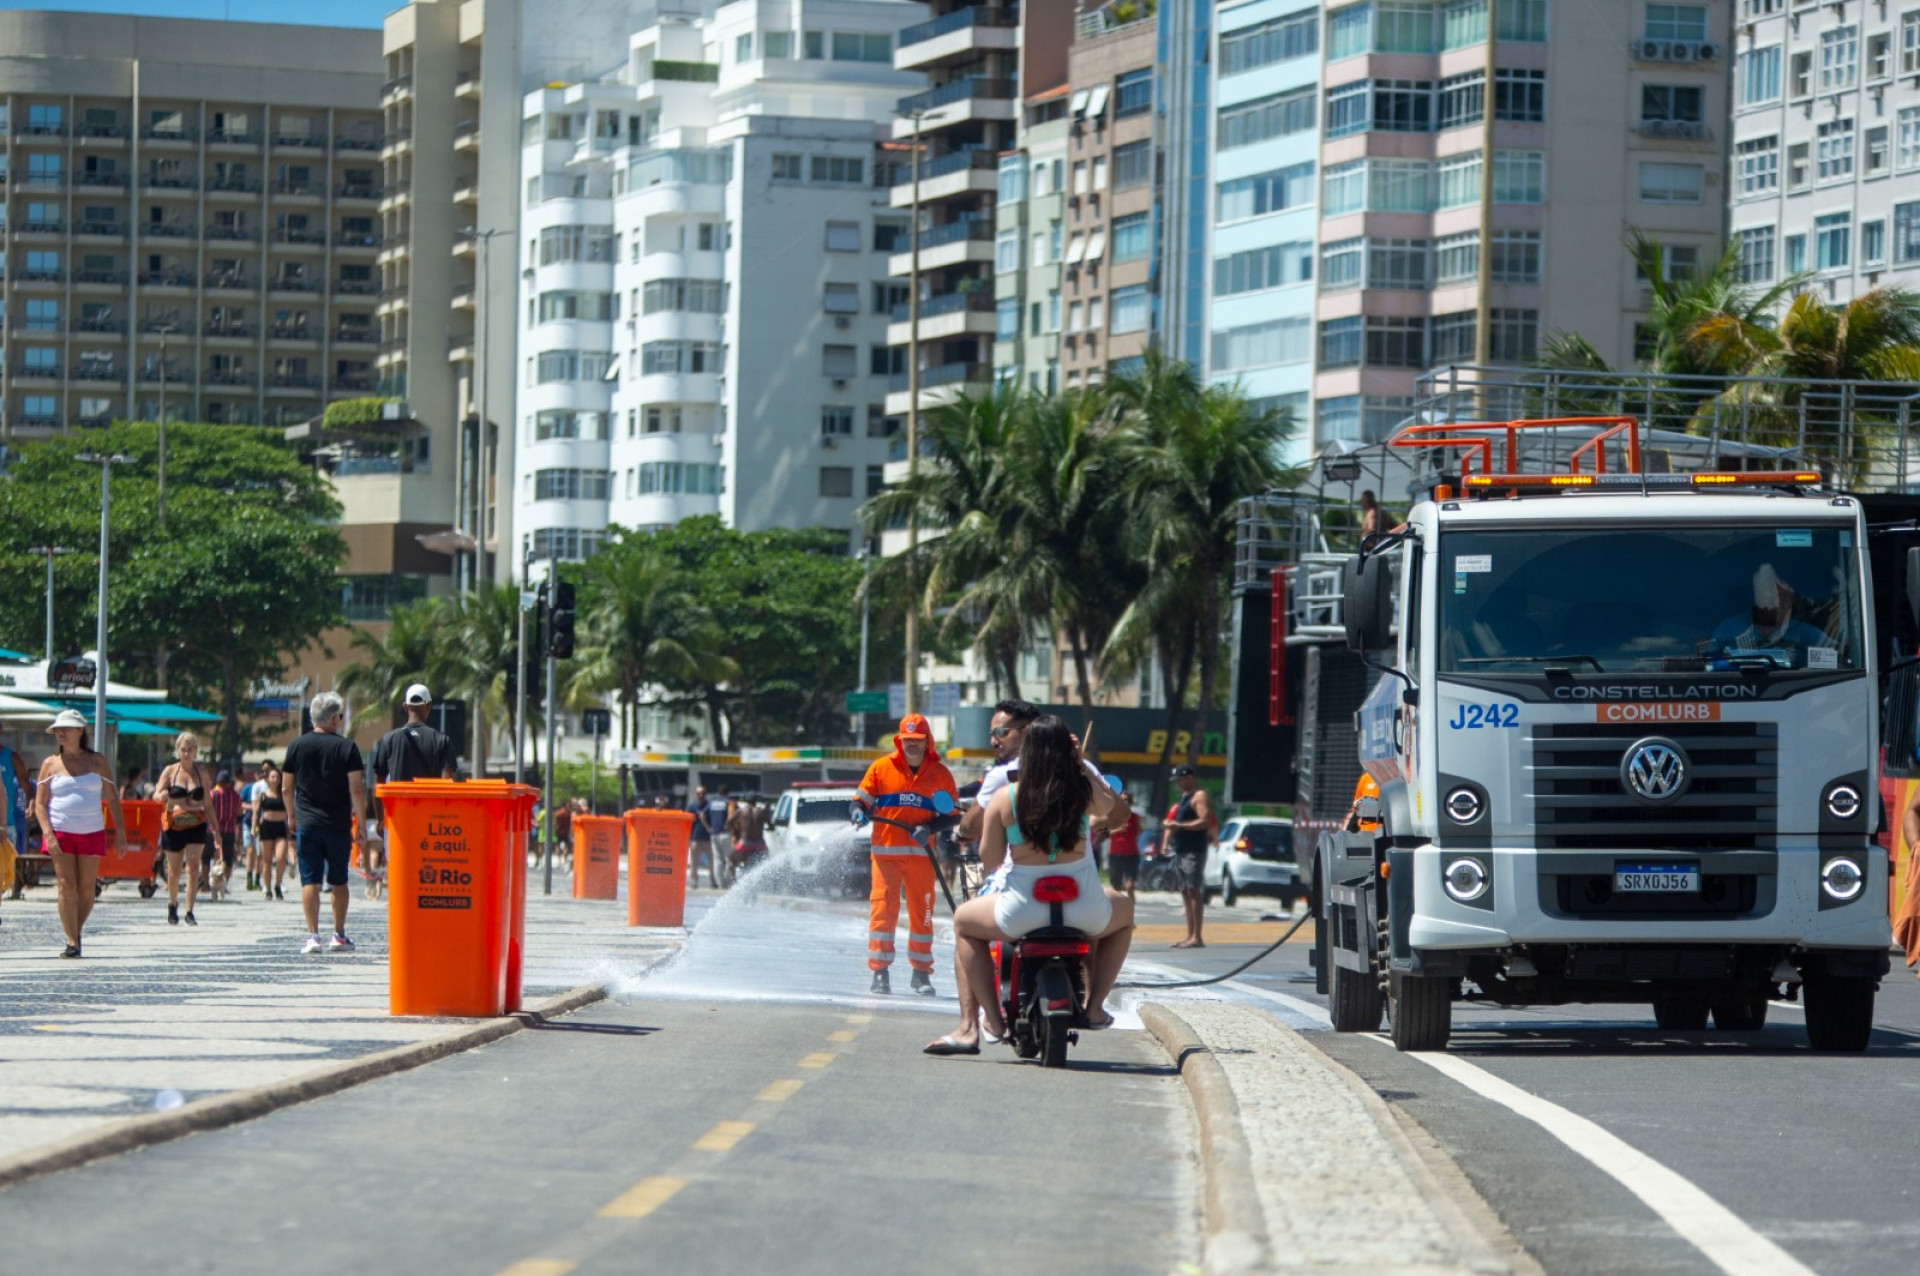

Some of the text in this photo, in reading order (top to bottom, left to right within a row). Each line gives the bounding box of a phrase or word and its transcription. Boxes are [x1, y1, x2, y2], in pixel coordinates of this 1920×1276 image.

[1554, 685, 1757, 699] CONSTELLATION
[1450, 703, 1519, 730] J242
[1607, 703, 1711, 721] COMLURB
[1146, 729, 1192, 754] BR
[428, 822, 462, 836] Lixo
[420, 838, 471, 854] é aqui.
[440, 869, 472, 885] Rio
